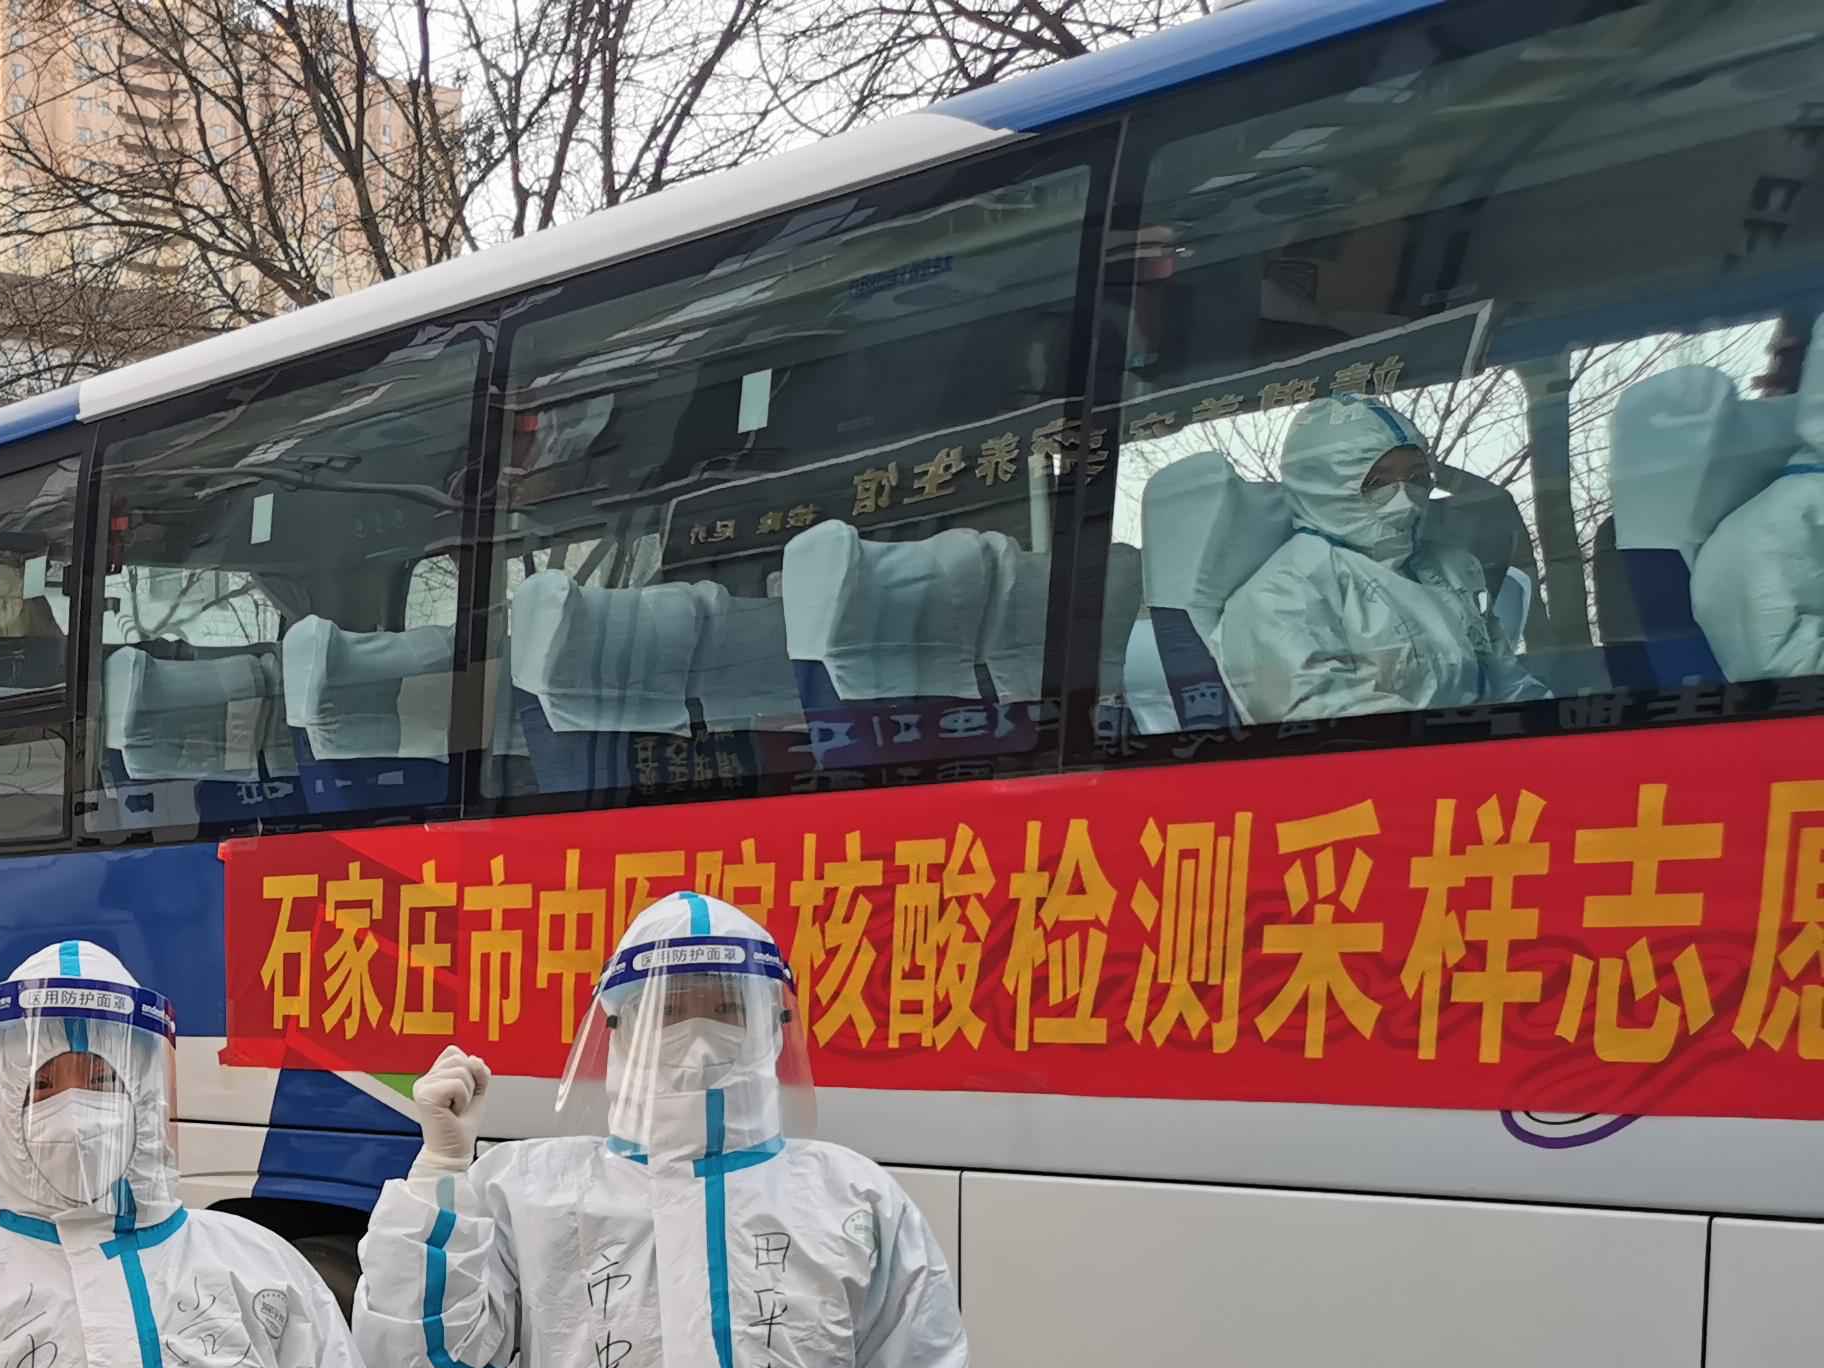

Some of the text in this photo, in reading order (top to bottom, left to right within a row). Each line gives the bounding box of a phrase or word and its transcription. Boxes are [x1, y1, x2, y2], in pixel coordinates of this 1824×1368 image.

[30, 989, 127, 1010] 医用防护面罩
